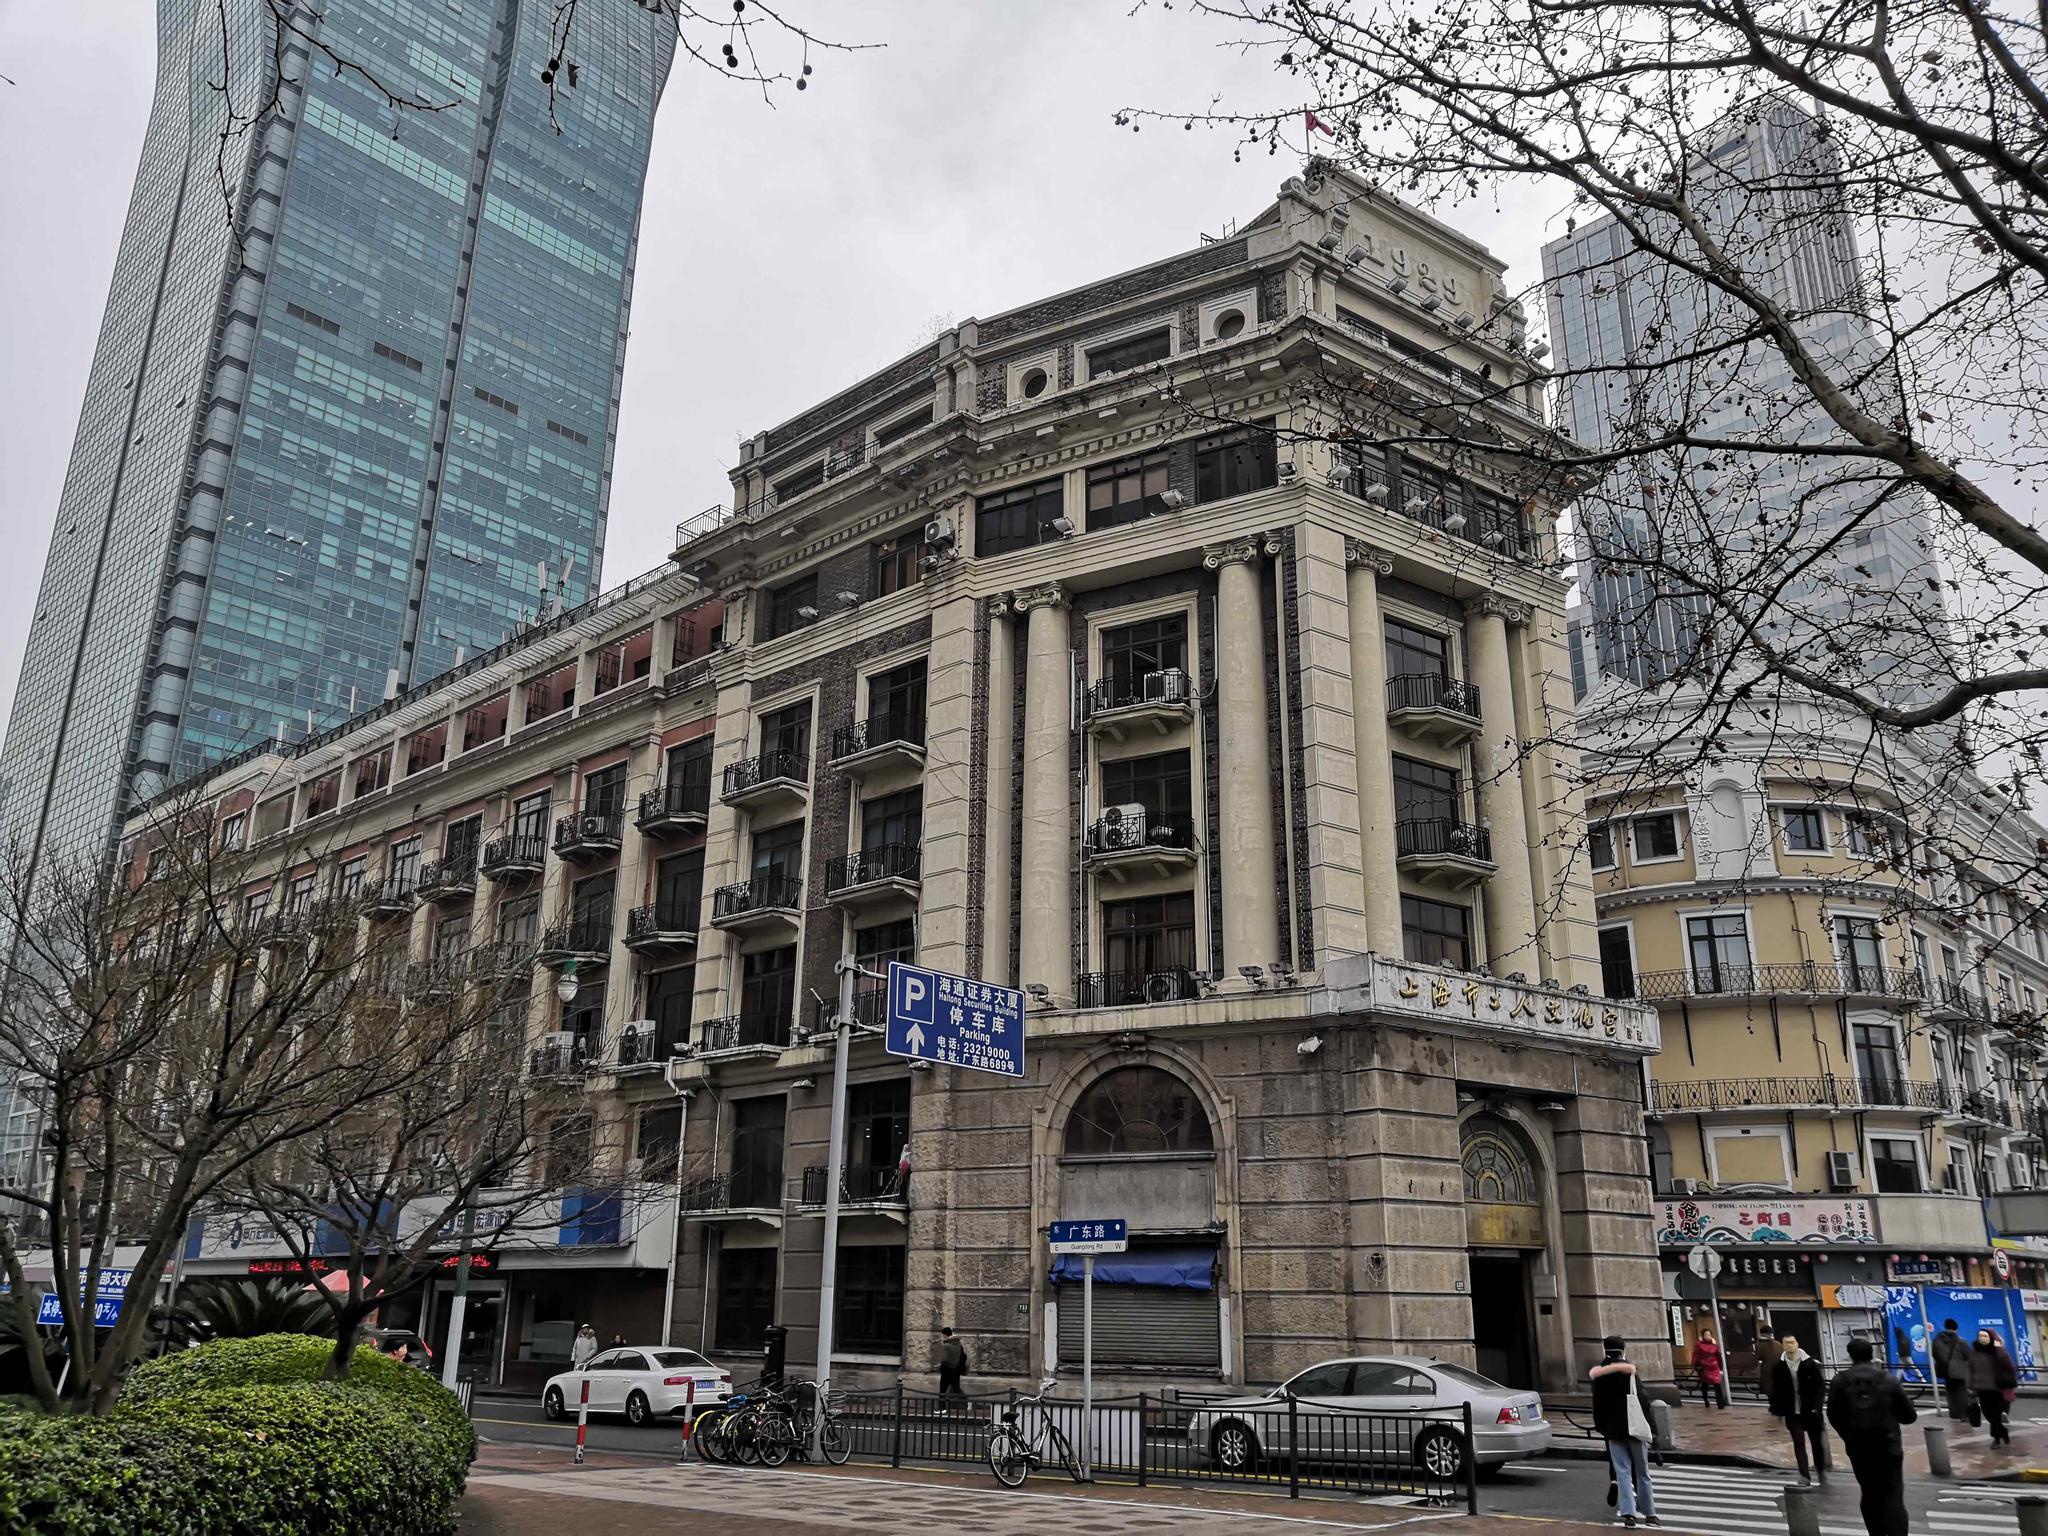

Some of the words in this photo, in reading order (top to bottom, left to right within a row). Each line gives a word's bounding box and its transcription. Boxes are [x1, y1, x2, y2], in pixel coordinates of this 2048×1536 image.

[905, 976, 926, 1011] P
[939, 976, 1018, 1009] 海通证券大厦
[938, 991, 961, 1007] Haitong
[963, 997, 992, 1012] Securities
[994, 1004, 1018, 1020] Building
[949, 1005, 1005, 1034] 停车库
[960, 1027, 991, 1045] Parking
[963, 1042, 1010, 1060] 23219000
[1739, 1212, 1791, 1226] 三町目
[1069, 1224, 1105, 1239] 广东路
